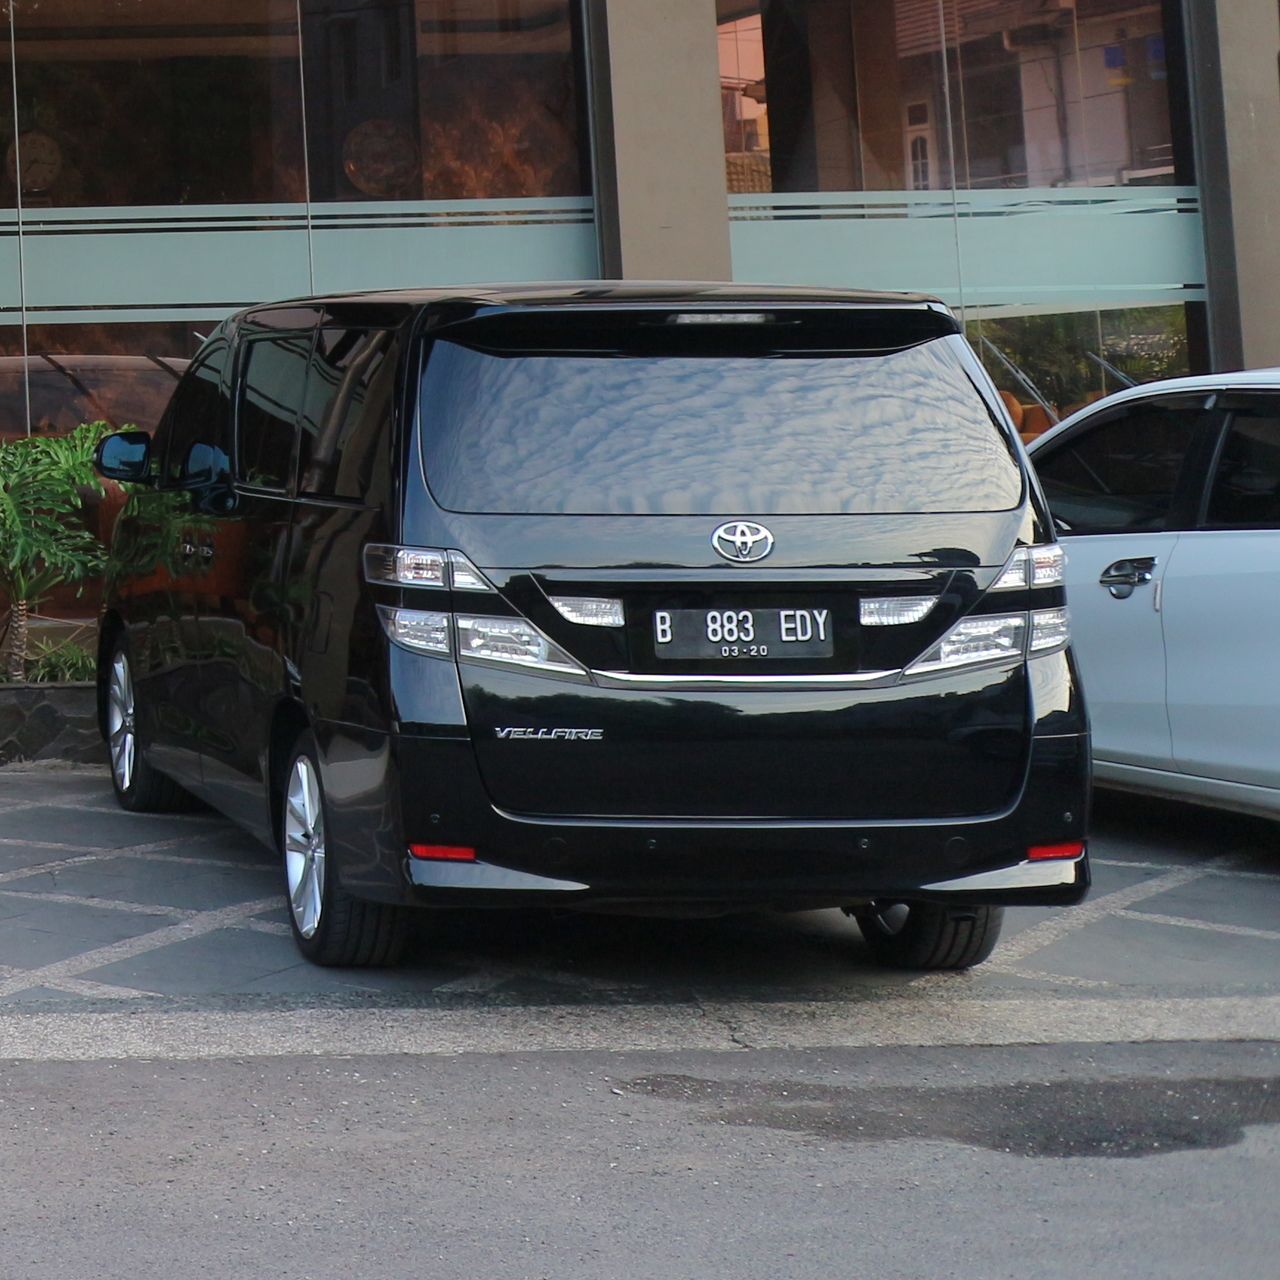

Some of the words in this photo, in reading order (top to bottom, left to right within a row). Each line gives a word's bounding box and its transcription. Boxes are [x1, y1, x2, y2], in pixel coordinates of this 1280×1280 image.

[656, 612, 673, 643] B
[706, 610, 755, 642] 883
[779, 609, 828, 642] EDY
[494, 727, 604, 740] VELLFIRE
